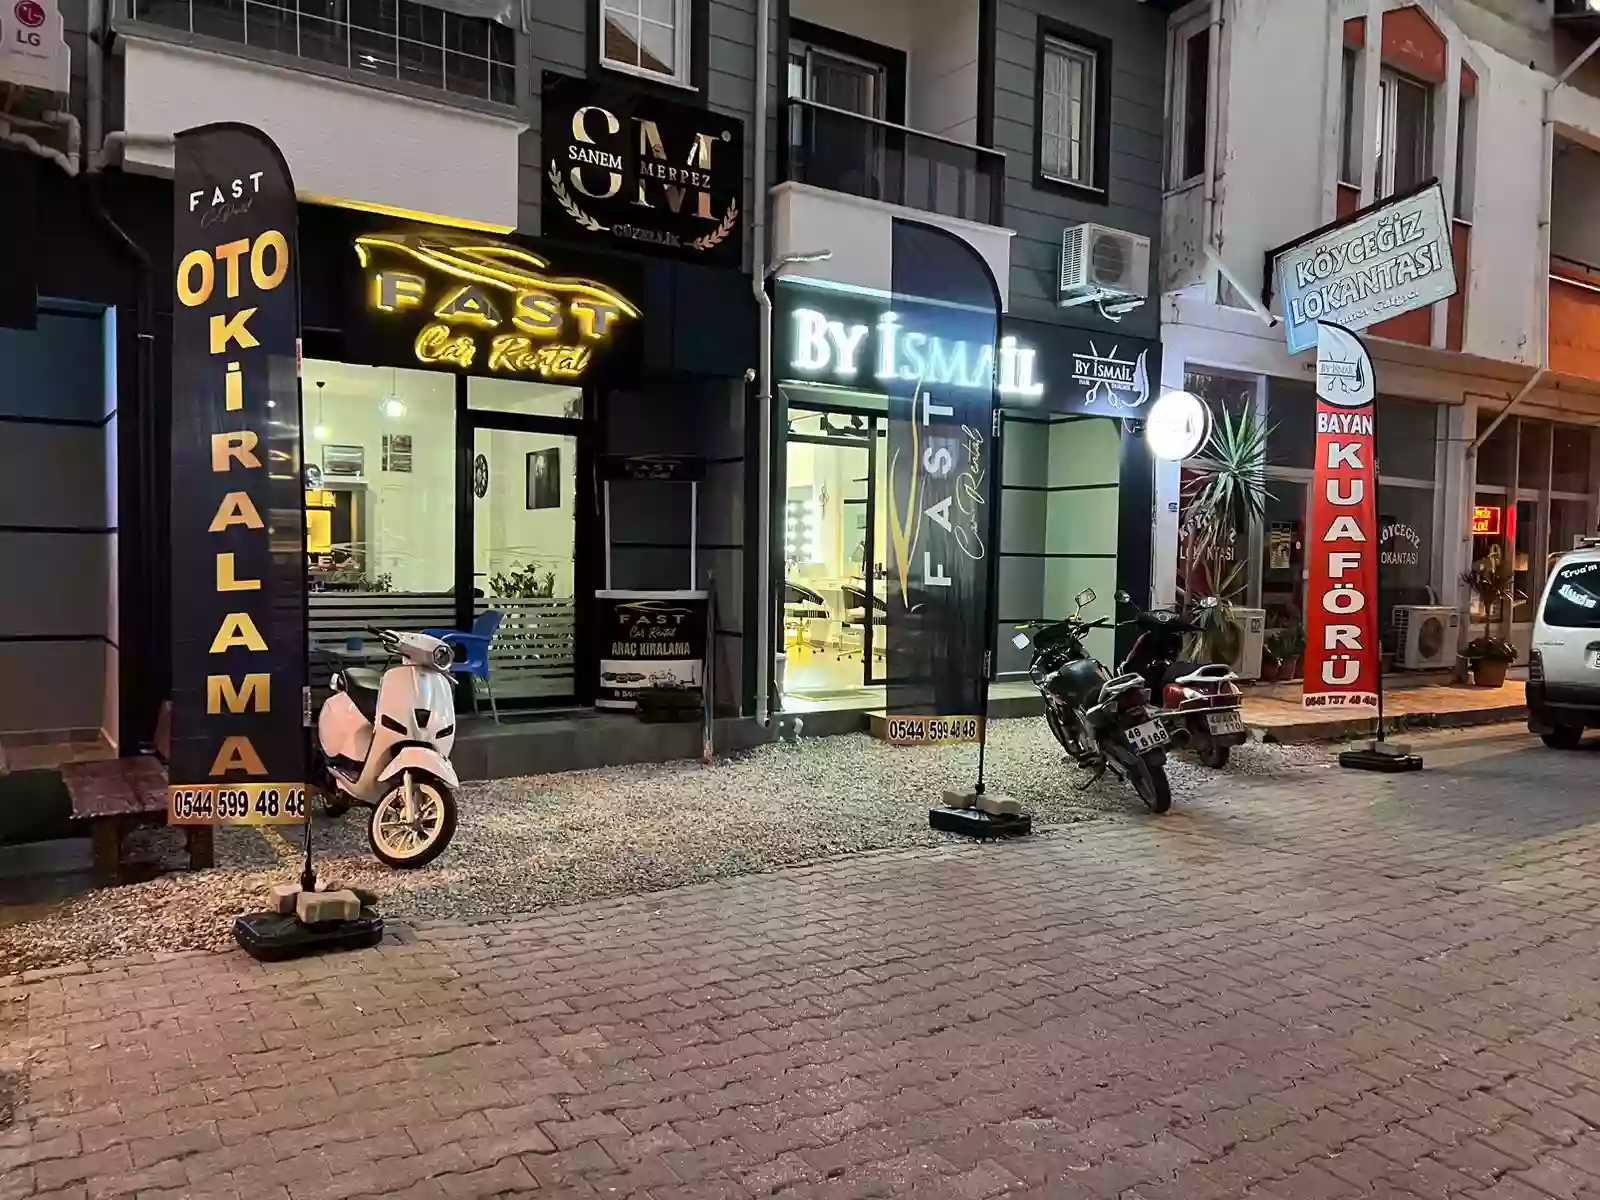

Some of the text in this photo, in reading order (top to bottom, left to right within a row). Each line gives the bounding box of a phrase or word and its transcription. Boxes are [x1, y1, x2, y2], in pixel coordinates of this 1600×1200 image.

[17, 29, 41, 46] LG
[568, 144, 623, 170] SANEM
[639, 160, 711, 189] MERPEZ
[189, 171, 264, 212] FAST
[176, 229, 289, 307] OTO
[1296, 210, 1424, 288] KÖYCEĞİZ
[374, 270, 619, 340] FAST
[1290, 240, 1442, 326] LOKANTASI
[414, 324, 593, 377] Car Rental
[789, 307, 870, 375] BY
[1075, 359, 1132, 381] BY İSMAİL
[1317, 411, 1374, 436] BAYAN
[922, 391, 954, 587] FAST
[956, 424, 985, 515] Rental
[206, 307, 271, 776] KİRALAMA
[1321, 441, 1367, 686] KUAFÖRÜ
[619, 614, 685, 624] FAST
[889, 720, 925, 740] 0544
[929, 720, 948, 740] 599
[963, 720, 976, 739] 48
[174, 791, 213, 818] 0544
[217, 790, 249, 818] 599
[254, 789, 281, 818] 48
